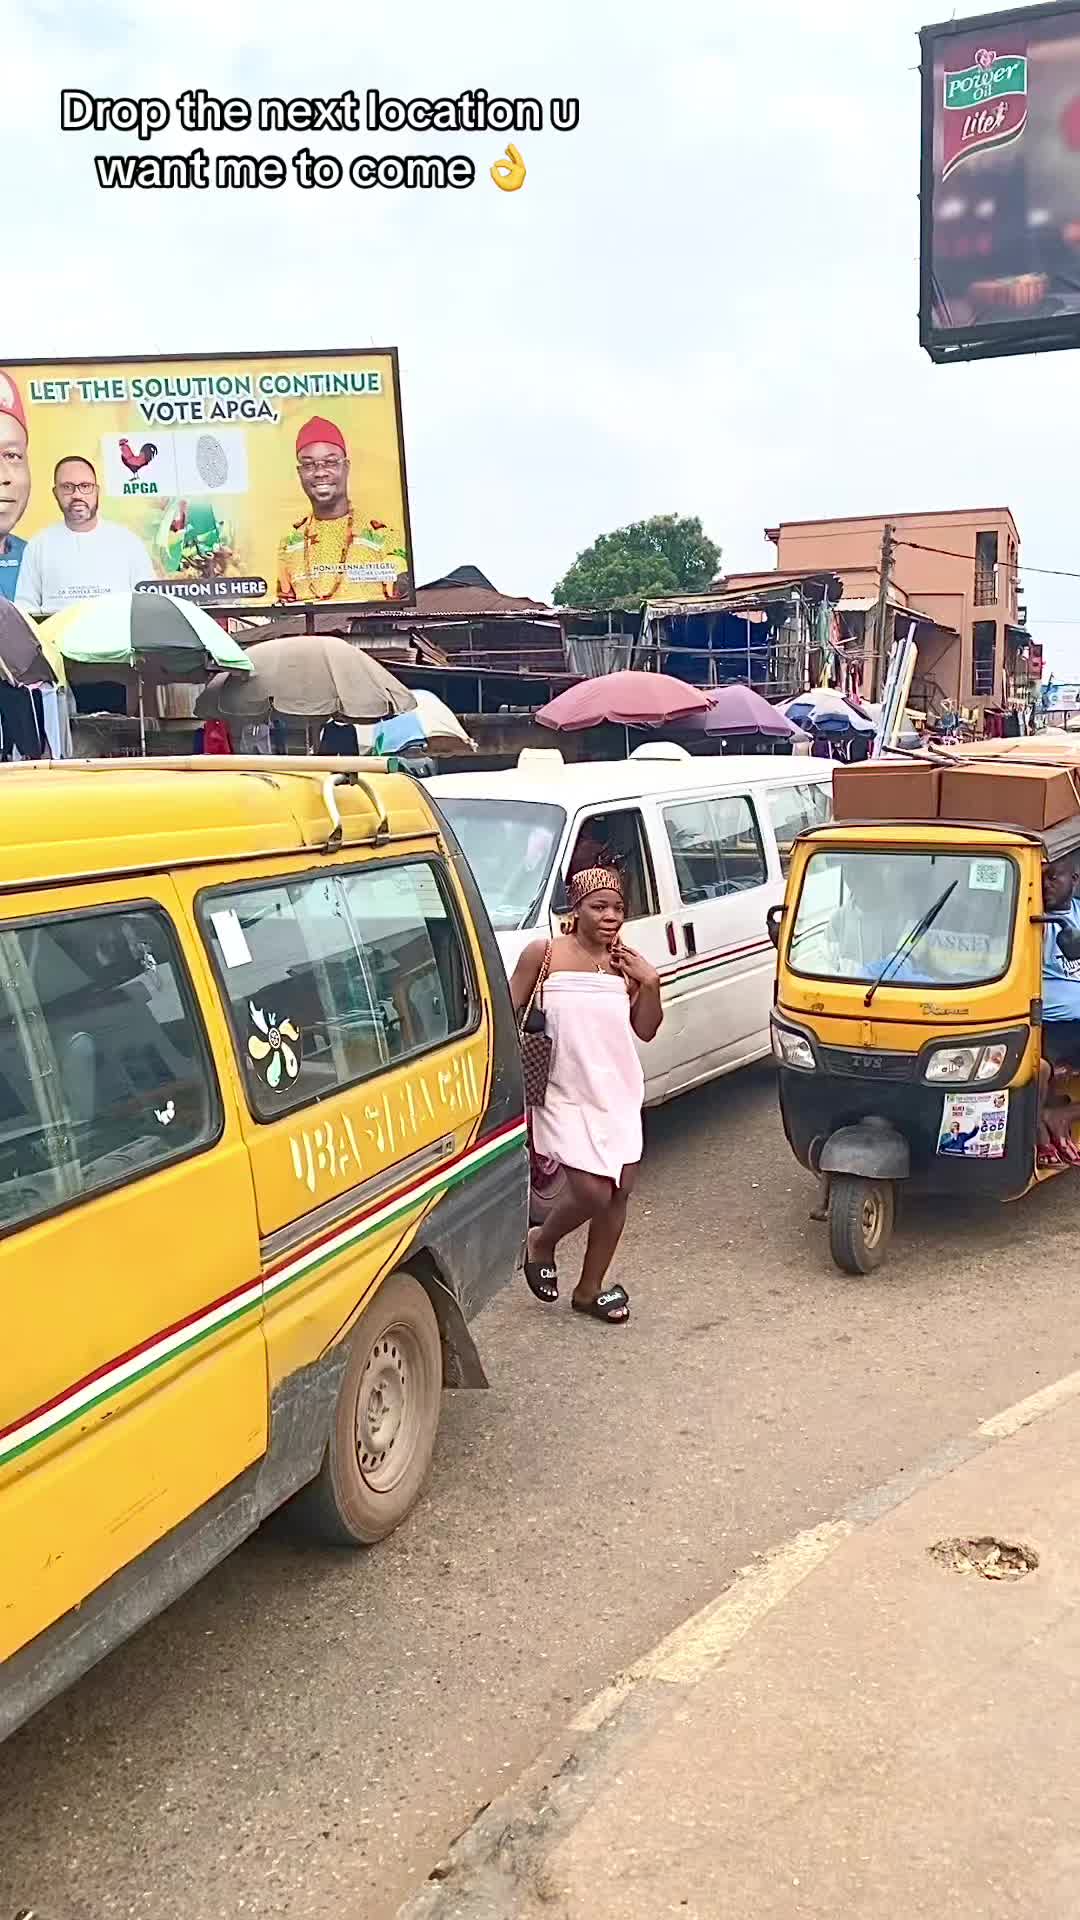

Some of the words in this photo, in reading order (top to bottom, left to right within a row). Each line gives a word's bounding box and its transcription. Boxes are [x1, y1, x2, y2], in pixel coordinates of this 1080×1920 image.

[973, 85, 992, 101] Oil
[30, 381, 70, 400] LET
[77, 379, 124, 399] THE
[131, 376, 251, 398] SOLUTION
[258, 372, 380, 394] CONTINUE
[140, 401, 202, 421] VOTE
[209, 400, 279, 421] APGA,
[122, 482, 158, 494] APGA
[139, 583, 211, 597] SOLUTION
[214, 583, 227, 595] IS
[231, 581, 266, 594] HERE
